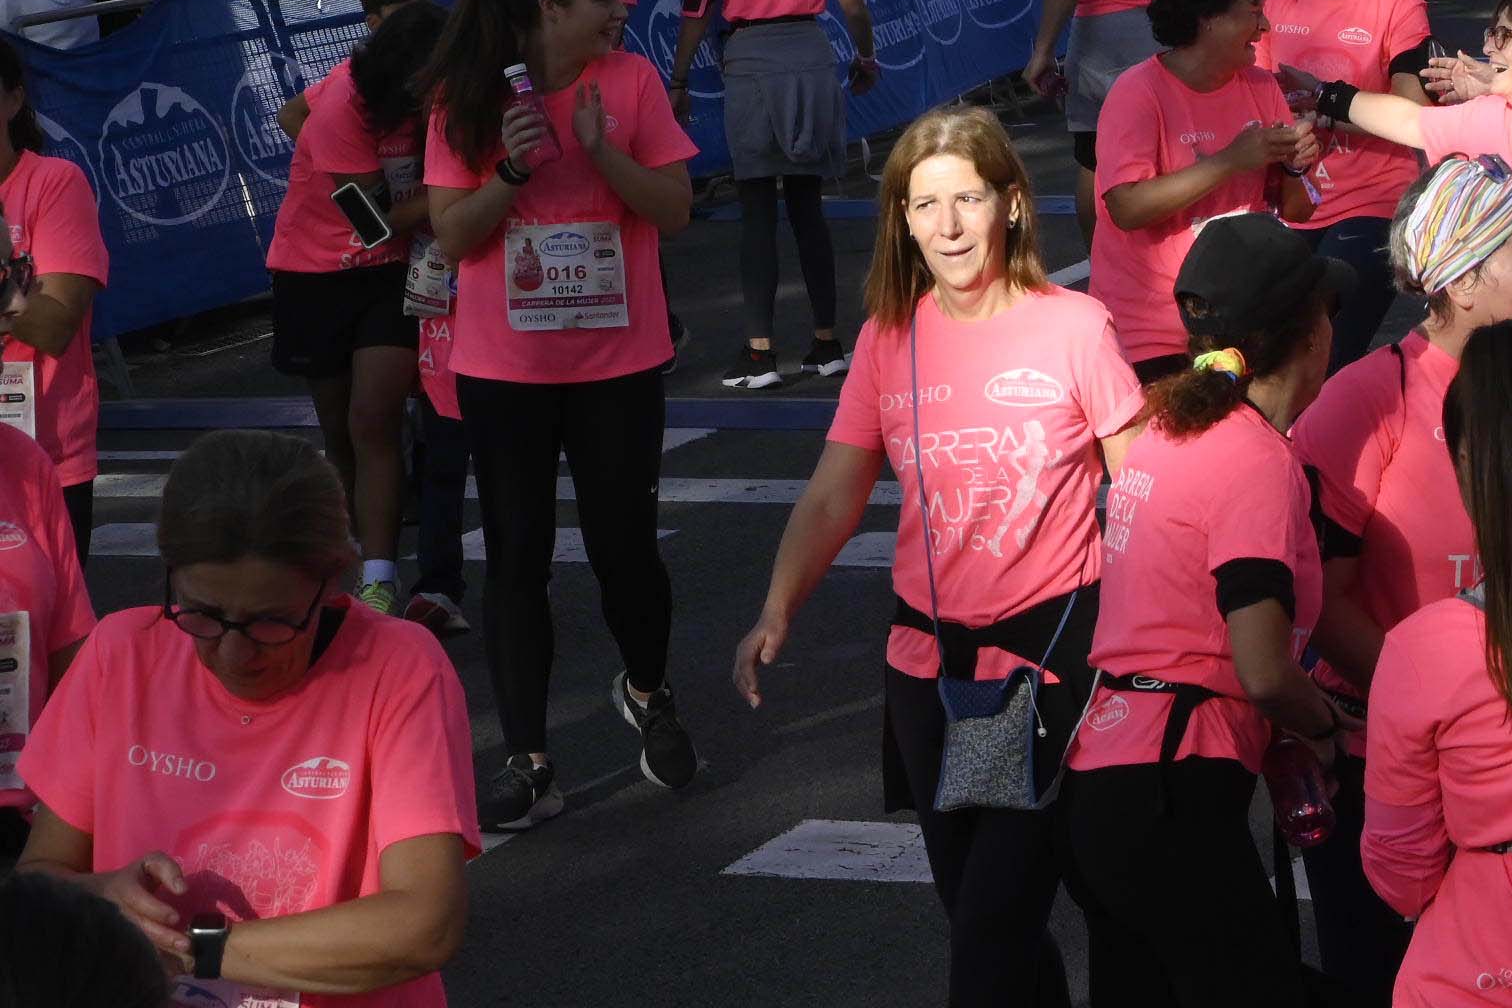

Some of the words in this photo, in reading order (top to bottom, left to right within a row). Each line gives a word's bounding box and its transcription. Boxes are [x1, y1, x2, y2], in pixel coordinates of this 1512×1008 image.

[1275, 23, 1310, 36] OYSHO
[111, 136, 225, 199] ASTURIANA
[546, 265, 588, 281] 016
[551, 284, 584, 295] 10142
[519, 312, 556, 323] OYSHO
[880, 384, 953, 411] OYSHO
[1110, 466, 1156, 503] ARRERA
[1109, 492, 1126, 520] DE
[128, 744, 216, 782] OYSHO
[287, 772, 351, 789] ASTURIAN
